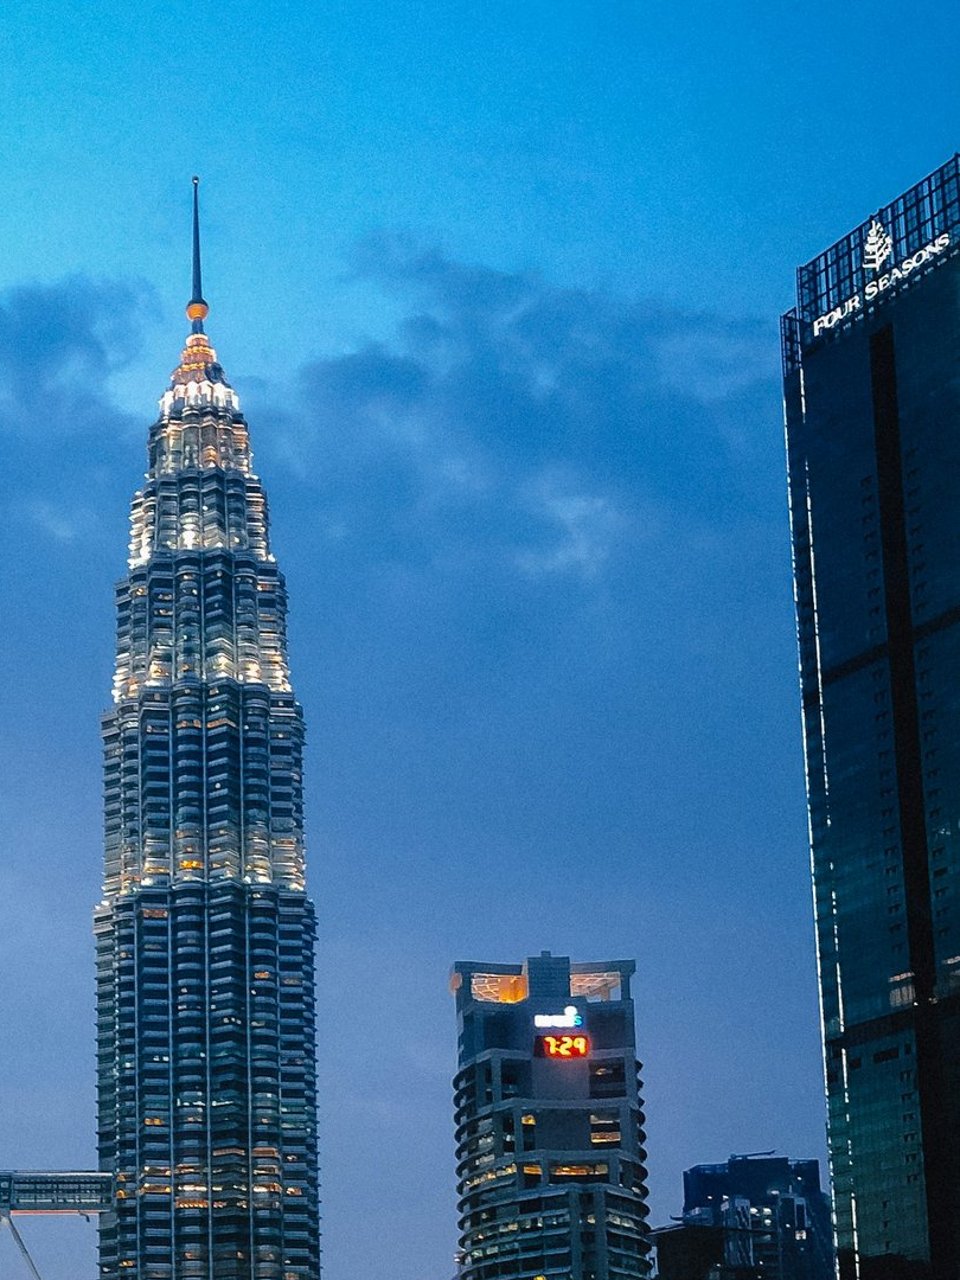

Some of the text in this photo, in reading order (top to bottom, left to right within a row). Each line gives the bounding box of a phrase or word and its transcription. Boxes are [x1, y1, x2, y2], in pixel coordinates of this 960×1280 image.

[813, 232, 950, 337] FOUR SEASONS
[543, 1036, 587, 1056] 7:29
